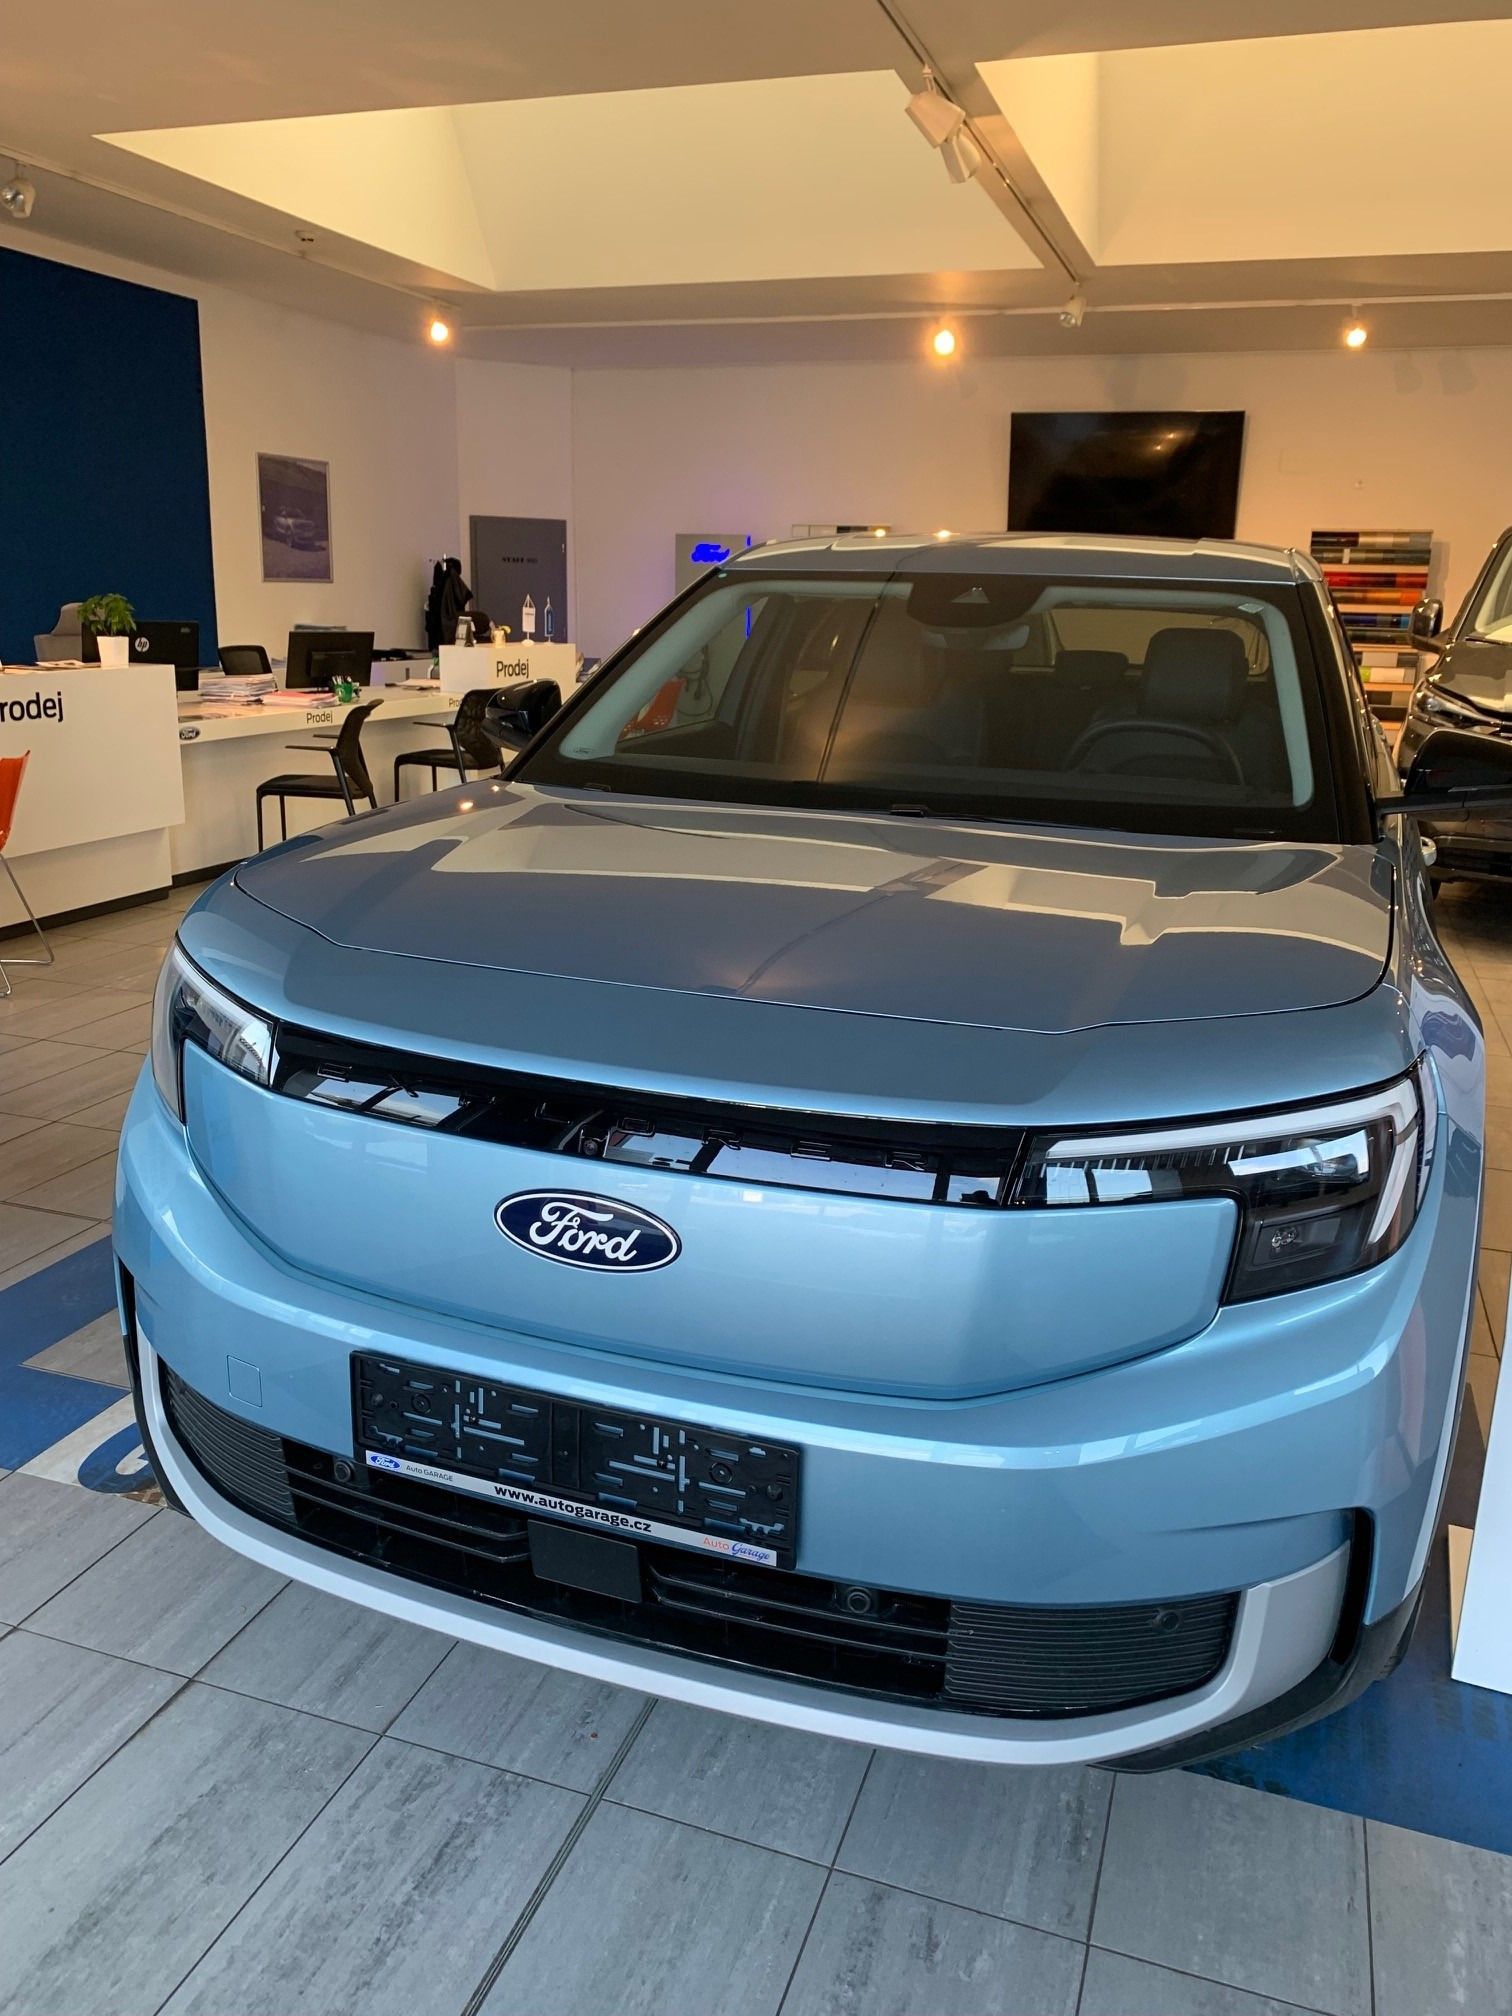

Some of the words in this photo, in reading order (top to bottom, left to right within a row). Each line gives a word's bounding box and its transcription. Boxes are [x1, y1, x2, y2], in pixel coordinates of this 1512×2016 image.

[135, 637, 149, 653] hp
[496, 658, 530, 679] Prodej
[0, 691, 64, 723] rodej
[448, 697, 462, 708] Pro
[306, 710, 333, 724] Prodej
[315, 1062, 929, 1172] EXLORER
[529, 1201, 642, 1262] Ford
[375, 1454, 396, 1469] Ford
[406, 1465, 423, 1474] Auto
[423, 1469, 455, 1482] GARAGE
[494, 1485, 652, 1533] www.autogarage.cz
[703, 1536, 730, 1551] Auto
[731, 1542, 771, 1561] Garage
